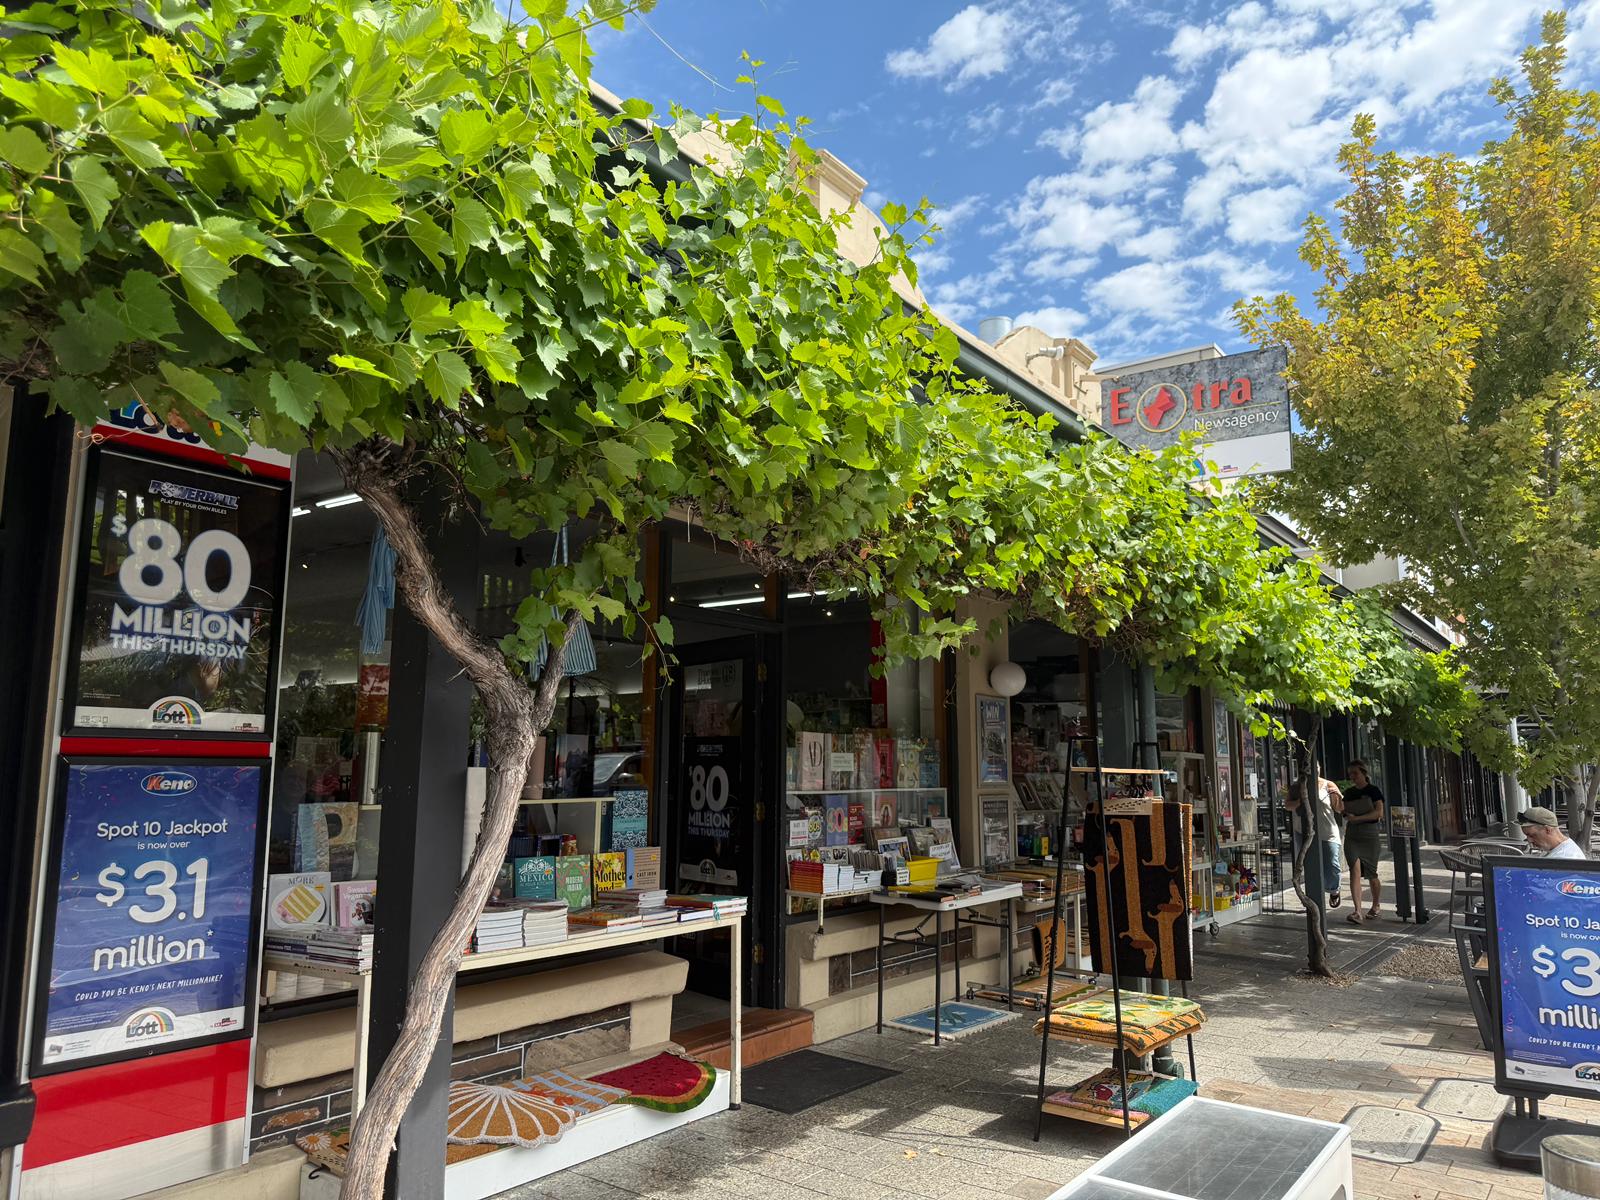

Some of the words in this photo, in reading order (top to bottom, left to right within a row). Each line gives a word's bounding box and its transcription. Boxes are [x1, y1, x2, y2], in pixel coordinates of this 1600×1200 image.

[1194, 409, 1279, 431] Newsagency
[111, 603, 250, 643] MILLION
[110, 633, 153, 651] THIS
[160, 637, 248, 659] THURSDAY
[147, 775, 195, 791] Keno
[689, 811, 730, 828] MILLION
[97, 822, 138, 841] Spot
[143, 821, 161, 836] 10
[165, 819, 228, 837] Jackpot
[137, 841, 145, 850] is
[147, 842, 167, 850] now
[168, 840, 190, 849] over
[520, 873, 553, 882] MEXICO
[596, 868, 626, 882] Mother
[95, 858, 208, 924] $3.1
[1526, 914, 1560, 928] Spot
[1563, 917, 1579, 928] 10
[75, 993, 98, 1001] COULD
[101, 989, 115, 998] YOU
[117, 987, 127, 996] BE
[129, 984, 155, 995] KENO'S
[157, 981, 176, 991] NEXT
[177, 974, 224, 987] MILLIONAIRE?
[1539, 1004, 1600, 1029] milli
[1529, 1036, 1547, 1044] COULD
